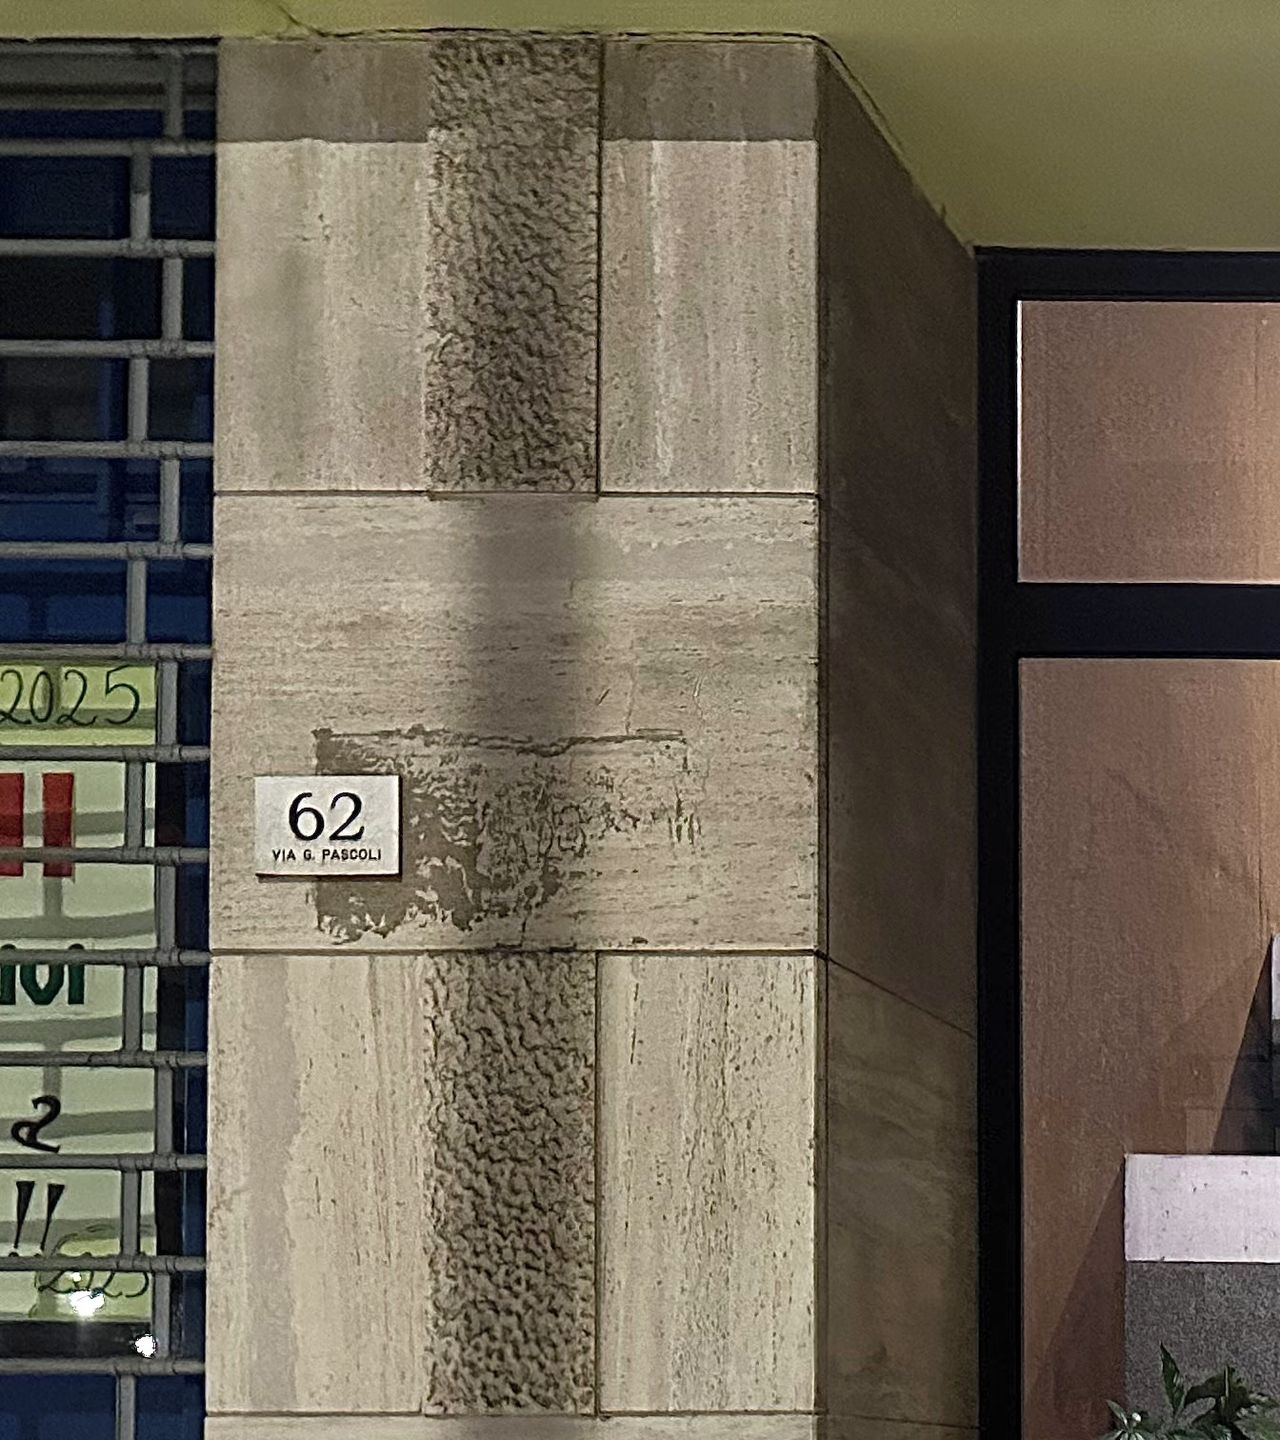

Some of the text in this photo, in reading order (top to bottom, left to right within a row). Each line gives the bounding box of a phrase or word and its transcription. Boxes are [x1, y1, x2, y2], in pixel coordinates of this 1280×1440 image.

[0, 664, 140, 724] 2025
[287, 791, 366, 842] 62
[272, 848, 382, 862] VIA G. PASCOLI
